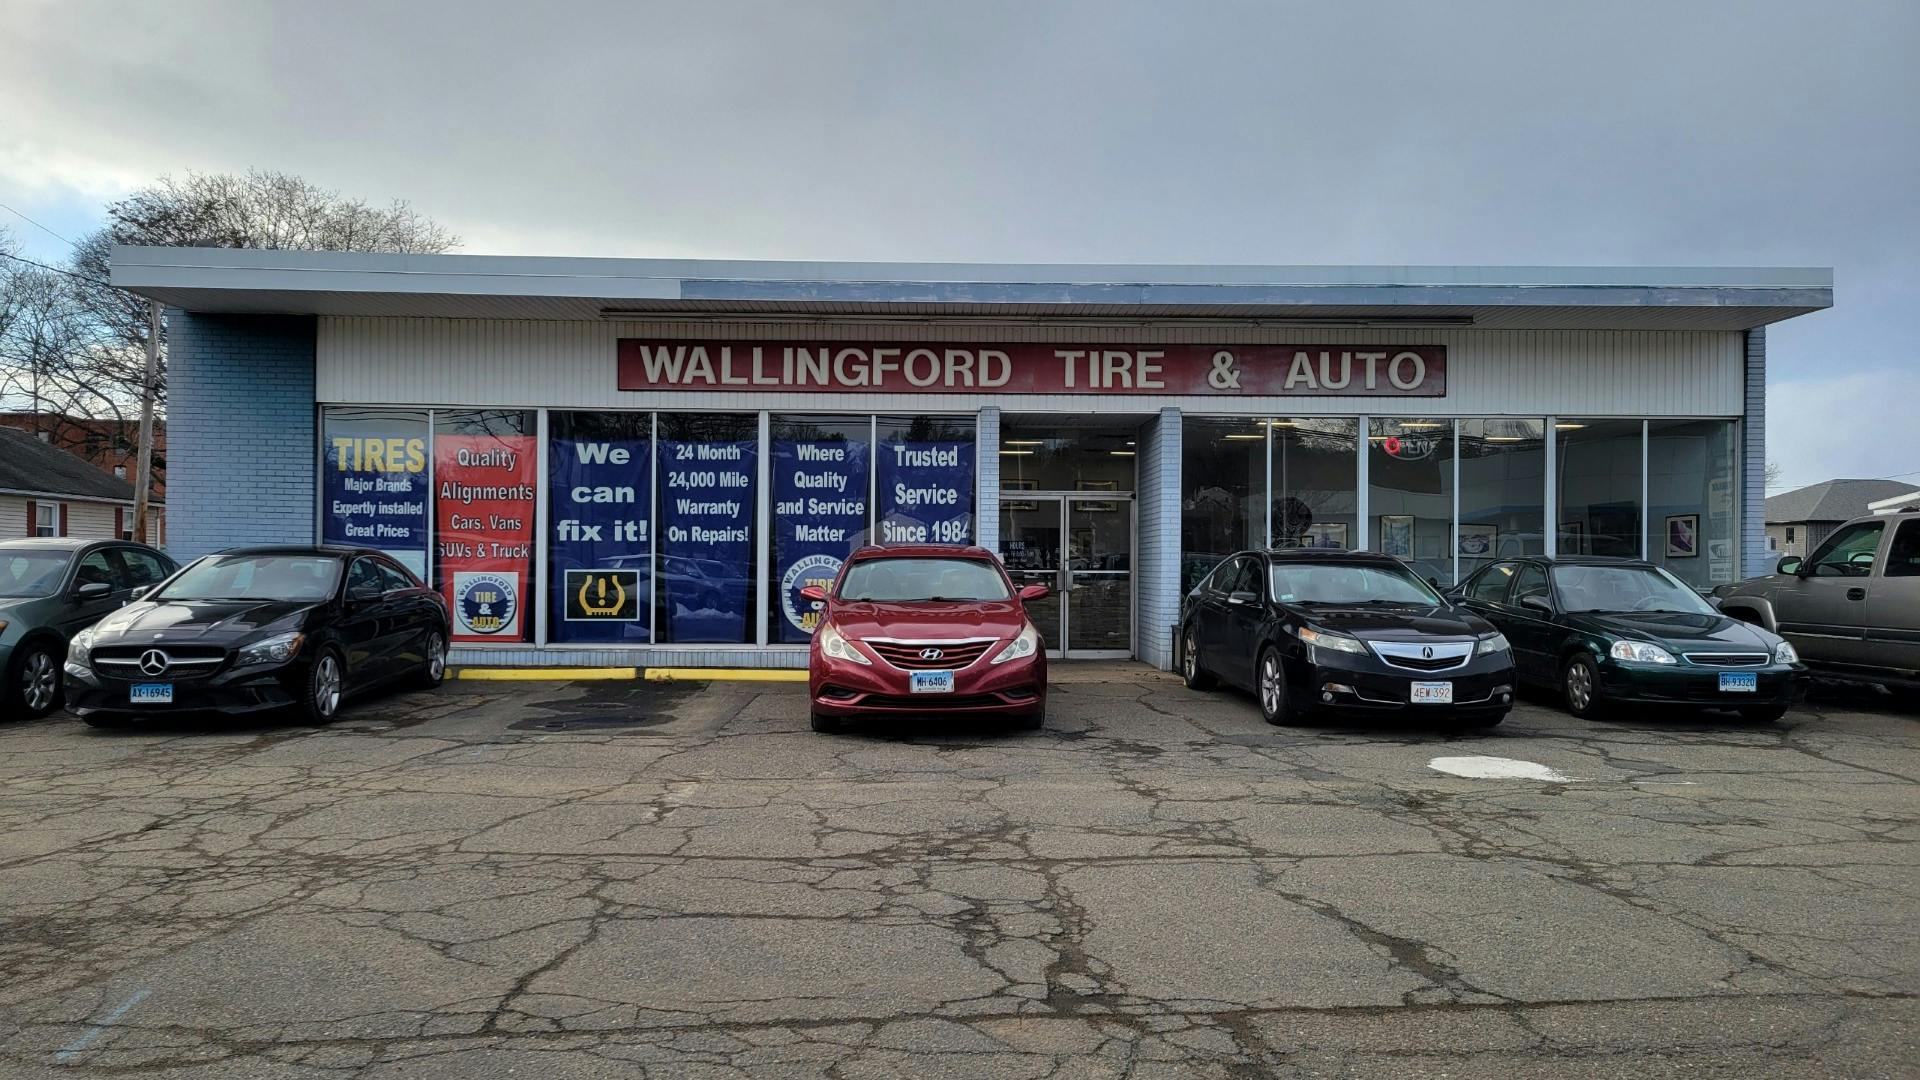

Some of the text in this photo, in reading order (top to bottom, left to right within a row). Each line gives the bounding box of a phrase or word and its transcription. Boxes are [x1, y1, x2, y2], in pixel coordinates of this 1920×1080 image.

[640, 345, 1426, 391] WALLINGFORD TIRE & AUTO
[333, 438, 425, 473] TIRES
[458, 449, 517, 472] Quality
[576, 443, 630, 465] We
[676, 444, 741, 460] 24 Month
[797, 444, 845, 461] Where
[894, 445, 958, 467] Trusted
[344, 478, 412, 494] Major Brands
[668, 472, 749, 491] 24,000 Mile
[794, 471, 848, 493] Quality
[440, 482, 534, 504] Alignments
[571, 487, 635, 503] can
[895, 483, 958, 505] Service
[333, 500, 423, 517] Expertly installed
[677, 499, 741, 518] Warranty
[777, 498, 865, 515] and Service
[345, 523, 410, 537] Great Prices
[490, 514, 522, 529] Vans
[557, 520, 648, 542] fix it!
[882, 520, 927, 542] Since
[668, 526, 749, 546] On Repairs!
[795, 525, 846, 542] Matter
[477, 543, 486, 557] &
[459, 576, 512, 596] WALLINGFORD
[474, 591, 497, 604] TIRE
[479, 603, 492, 615] &
[472, 616, 501, 629] AUTO
